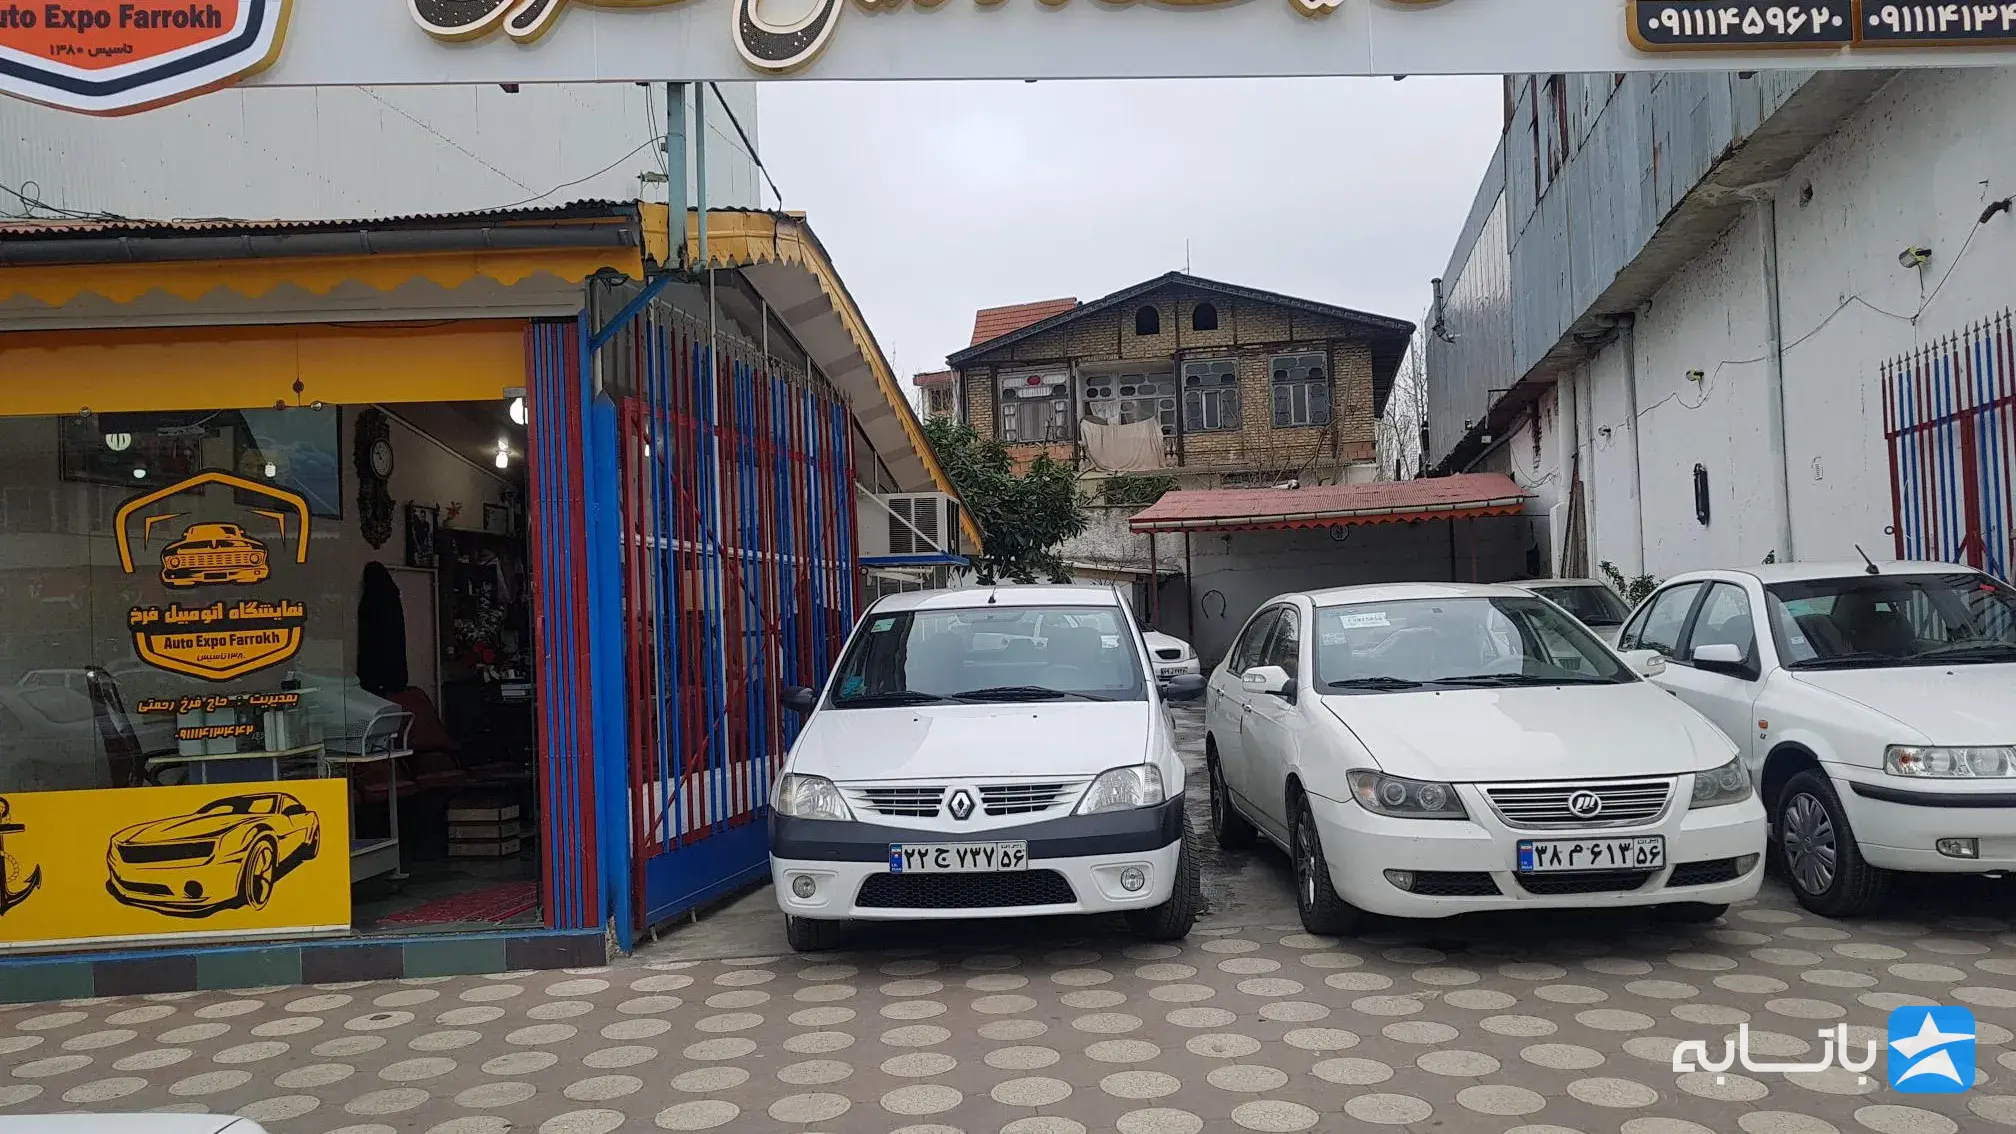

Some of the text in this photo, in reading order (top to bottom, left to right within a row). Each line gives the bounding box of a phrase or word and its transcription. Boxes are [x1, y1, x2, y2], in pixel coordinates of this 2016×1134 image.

[45, 4, 111, 33] Expo
[120, 4, 222, 28] Farrokh
[1648, 7, 1843, 36] ۰۹۱۱۱۴۵۹۶۲۰
[50, 44, 83, 55] ۱۳۸۰
[130, 600, 304, 625] نمایشگاه اتومبیل فرخ
[163, 631, 280, 650] Auto Expo Farrokh
[138, 700, 175, 713] رحمتی
[180, 696, 202, 713] فرخ
[206, 696, 228, 712] حاج
[956, 846, 995, 868] ۷۳۷
[1000, 848, 1025, 868] ۵۶
[1590, 842, 1631, 865] ۶۱۳
[1636, 845, 1661, 865] ۵۶
